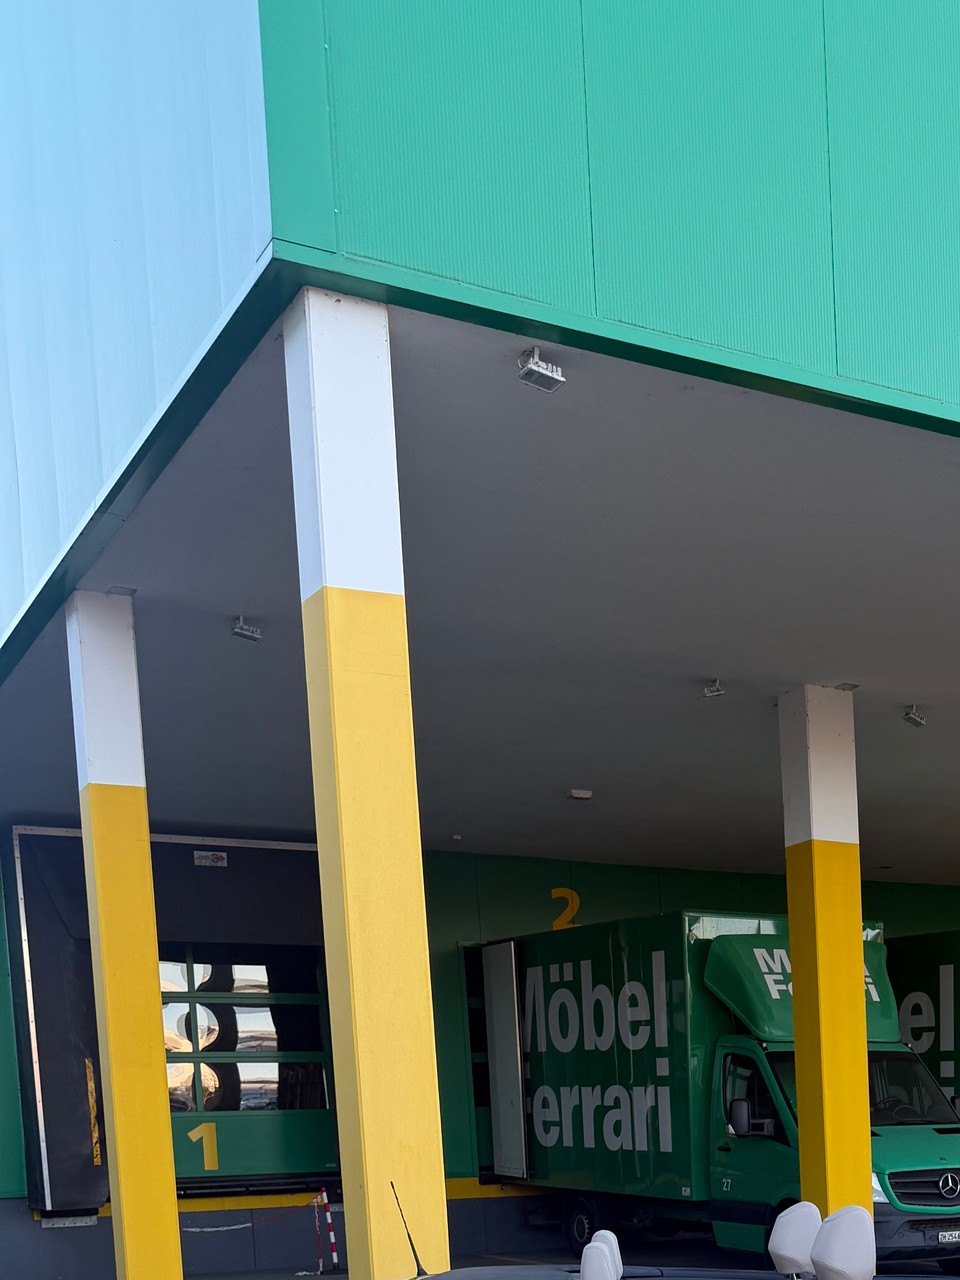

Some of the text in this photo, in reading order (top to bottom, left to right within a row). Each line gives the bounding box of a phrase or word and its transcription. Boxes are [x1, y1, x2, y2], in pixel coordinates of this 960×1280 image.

[551, 887, 582, 931] 2
[524, 1057, 673, 1153] errari
[187, 1122, 219, 1171] 1
[722, 1177, 732, 1192] 27
